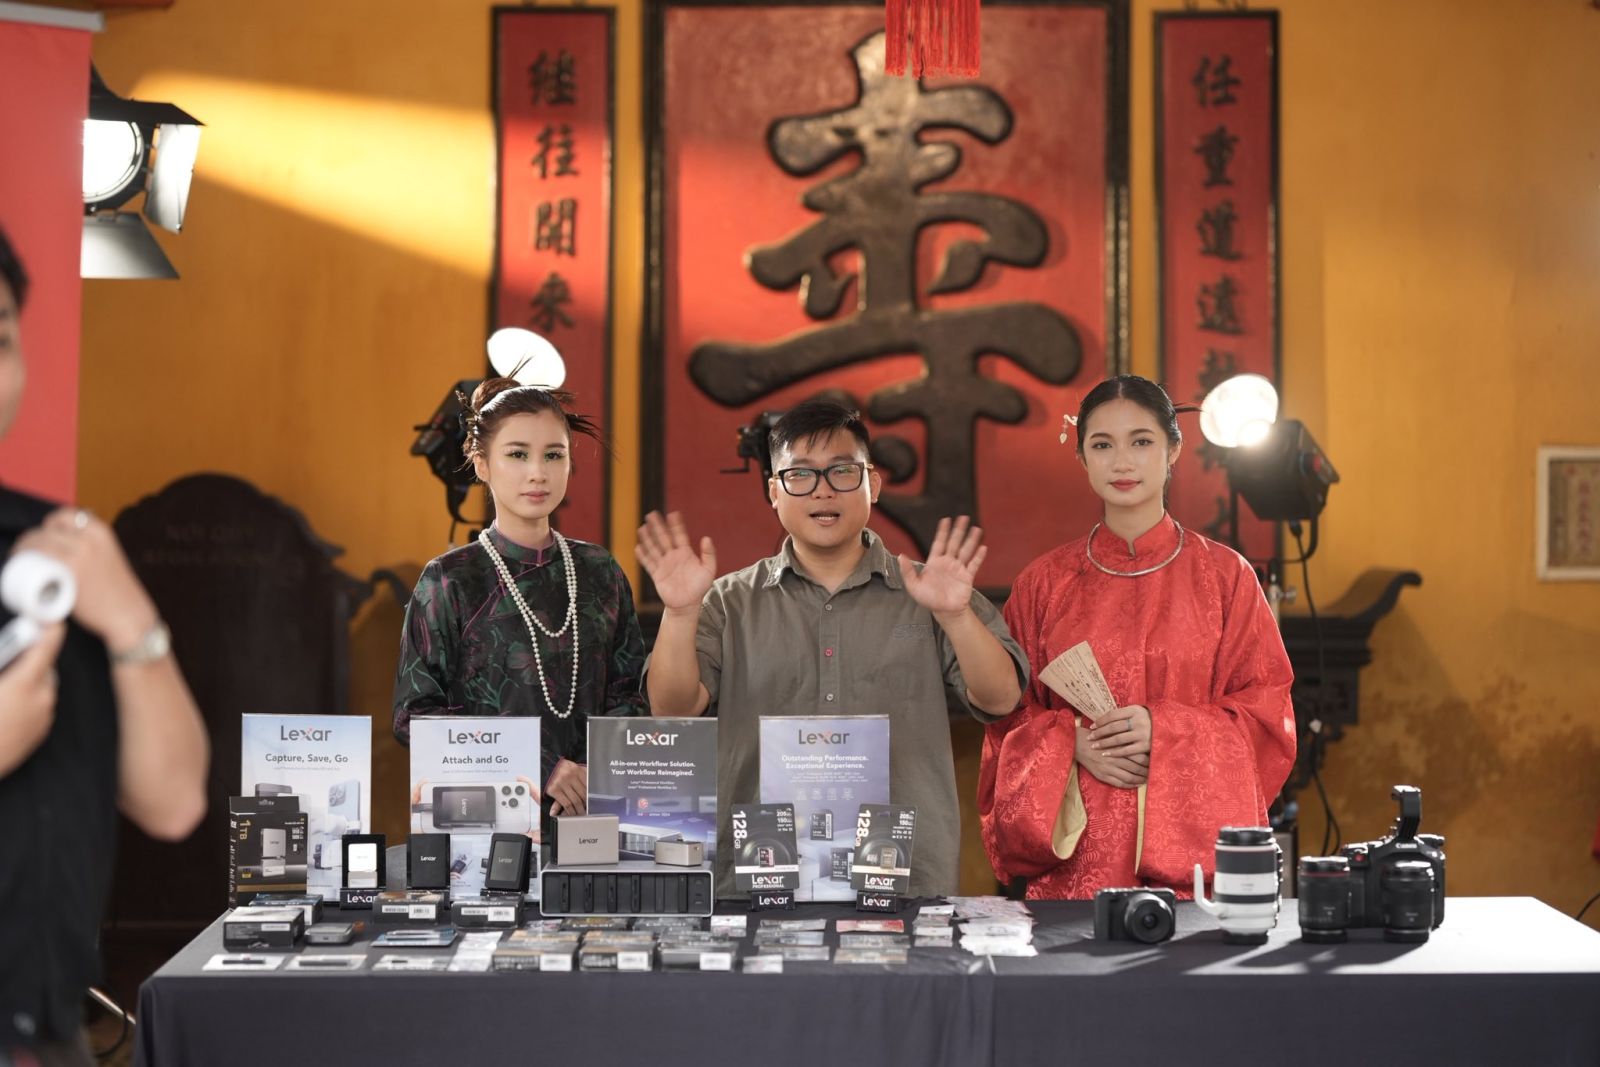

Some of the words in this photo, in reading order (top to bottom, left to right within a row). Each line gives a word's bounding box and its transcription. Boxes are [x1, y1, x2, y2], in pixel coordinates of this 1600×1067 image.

[280, 725, 332, 741] Lexar
[448, 728, 501, 744] Lexar
[626, 729, 678, 745] Lexar
[798, 729, 850, 744] Lexar
[265, 754, 304, 764] Capture,
[307, 754, 332, 763] Save,
[334, 754, 348, 763] Go
[442, 756, 473, 764] Attach
[475, 756, 492, 764] and
[495, 756, 509, 764] Go
[752, 874, 784, 884] Lexar
[865, 874, 895, 885] Lexar
[759, 896, 788, 904] Lexar
[863, 896, 891, 906] Lexar
